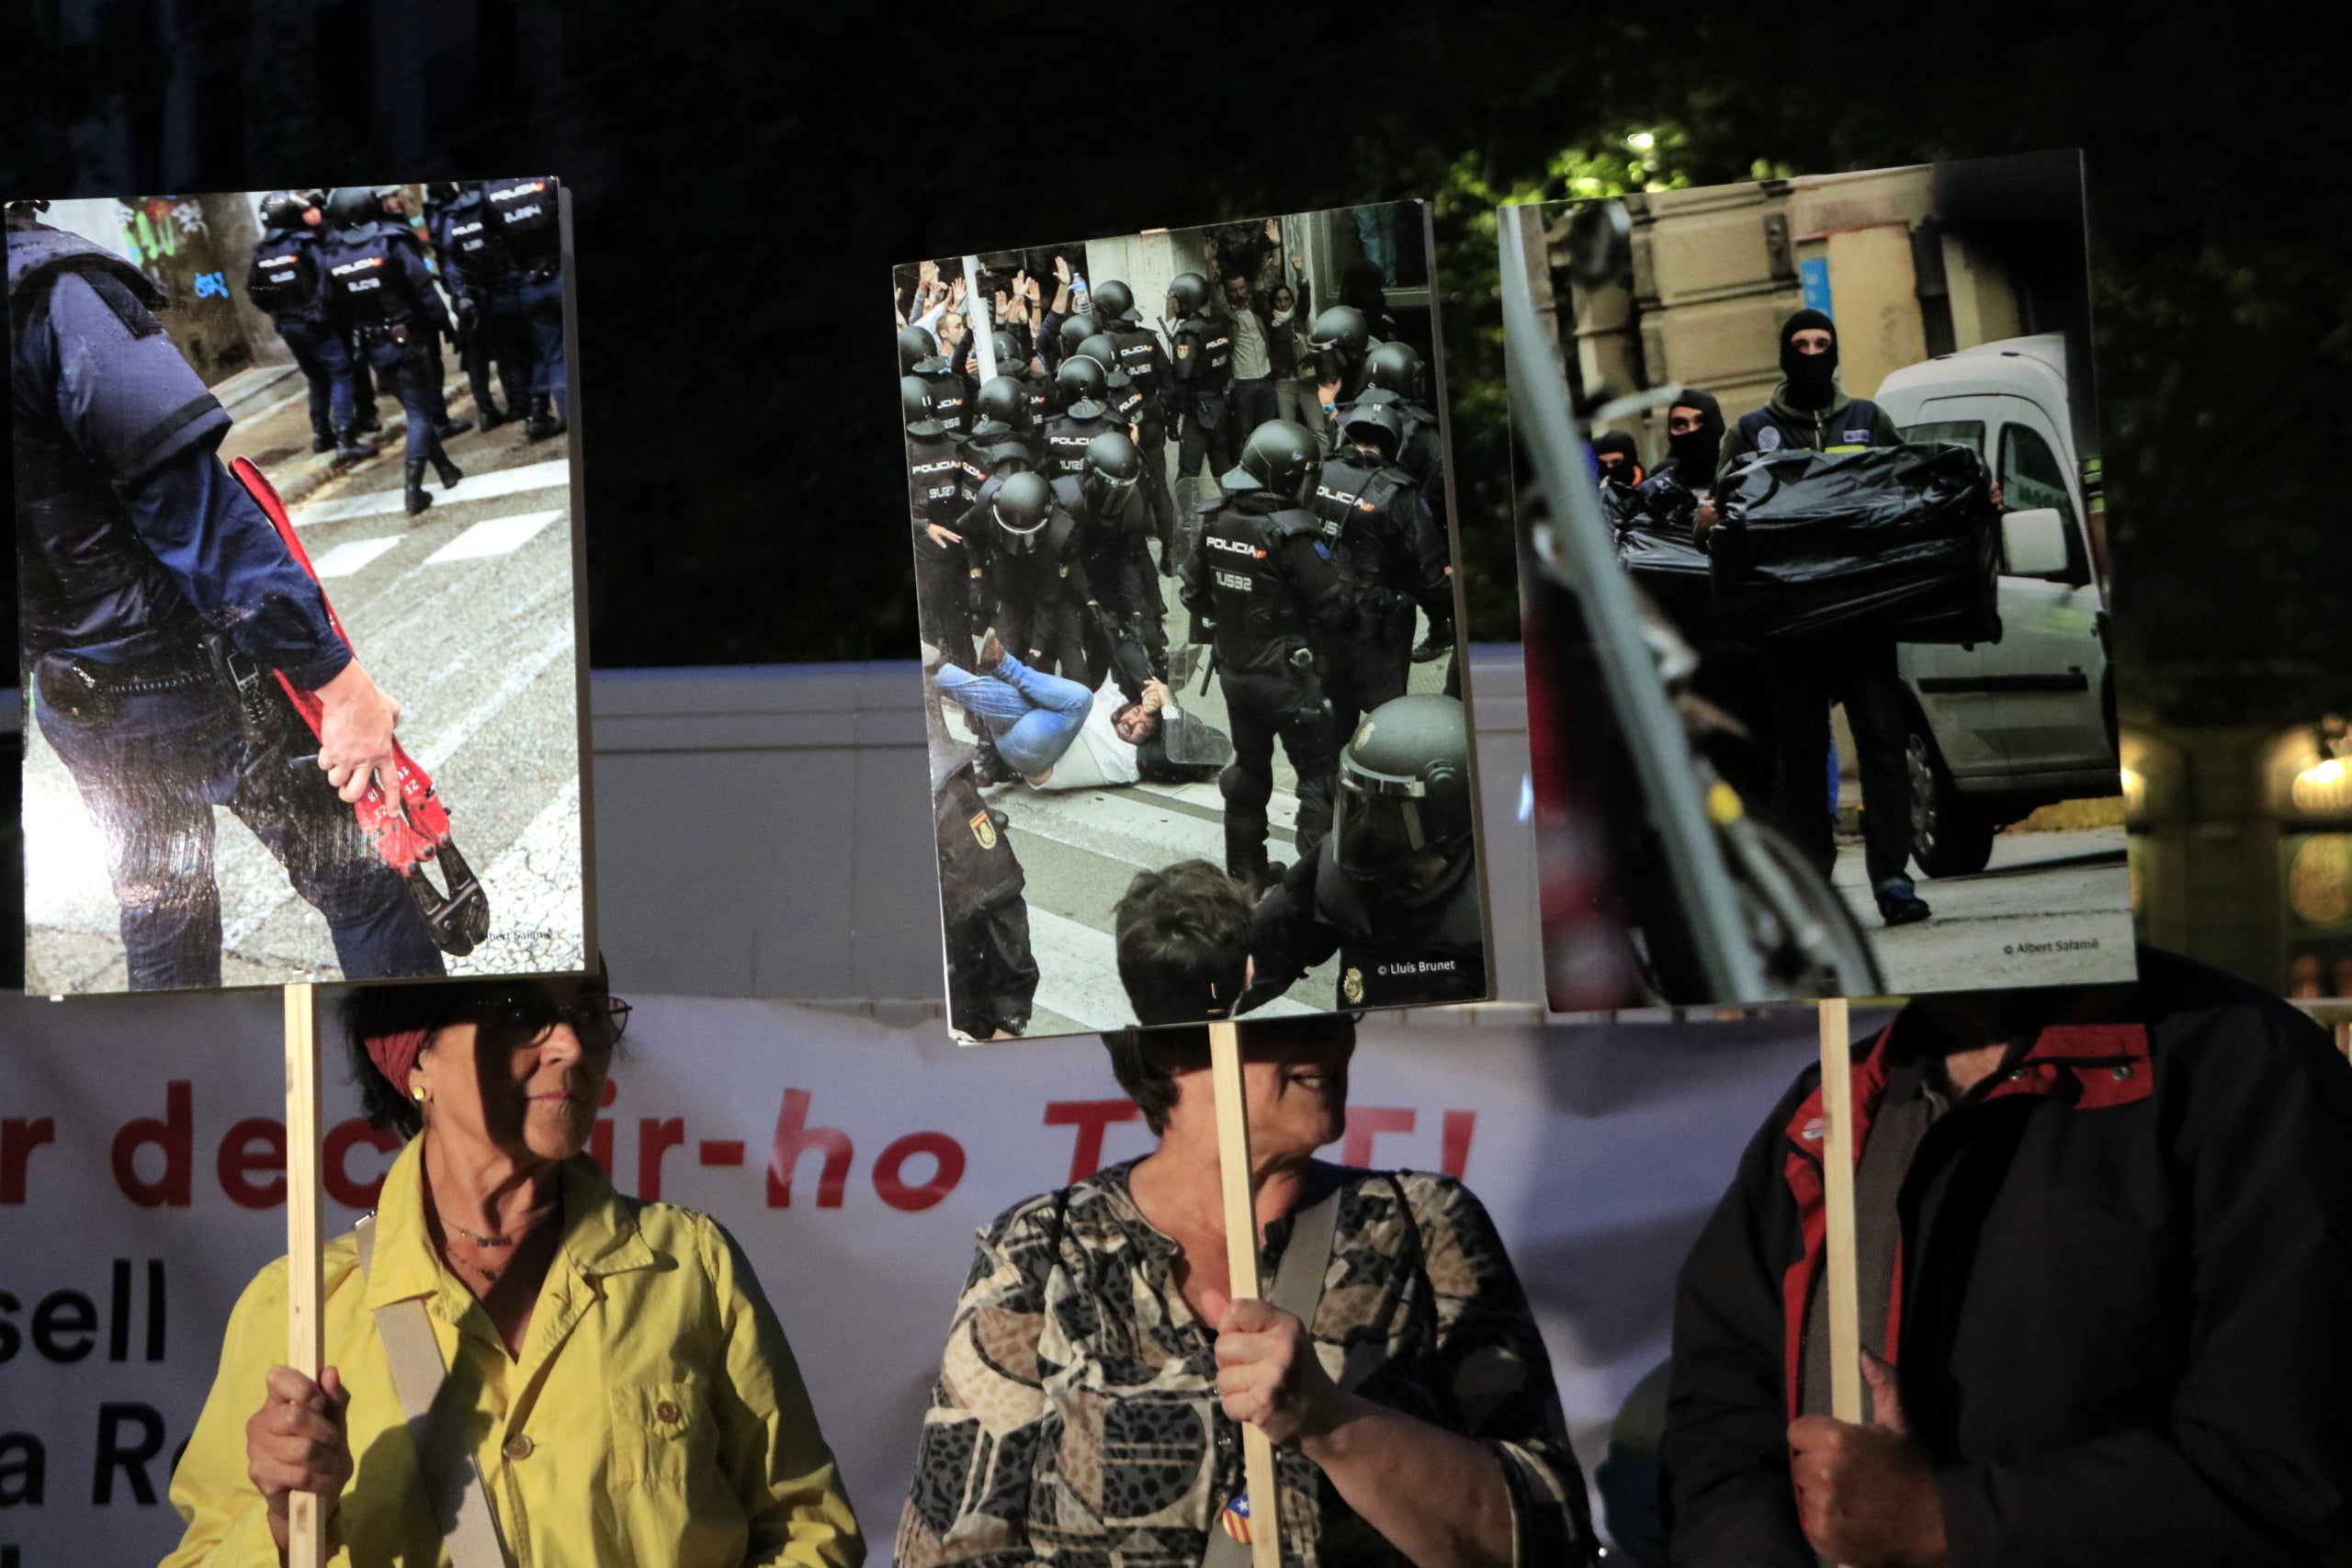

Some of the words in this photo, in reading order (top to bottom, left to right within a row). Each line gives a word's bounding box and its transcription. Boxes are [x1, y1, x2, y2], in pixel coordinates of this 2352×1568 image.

[1121, 344, 1149, 356] OLICIA
[912, 460, 957, 474] POLICIA
[1206, 536, 1257, 558] POLICIA
[2018, 942, 2052, 953] Albert
[1419, 960, 1455, 972] Brunet
[93, 1402, 191, 1505] R
